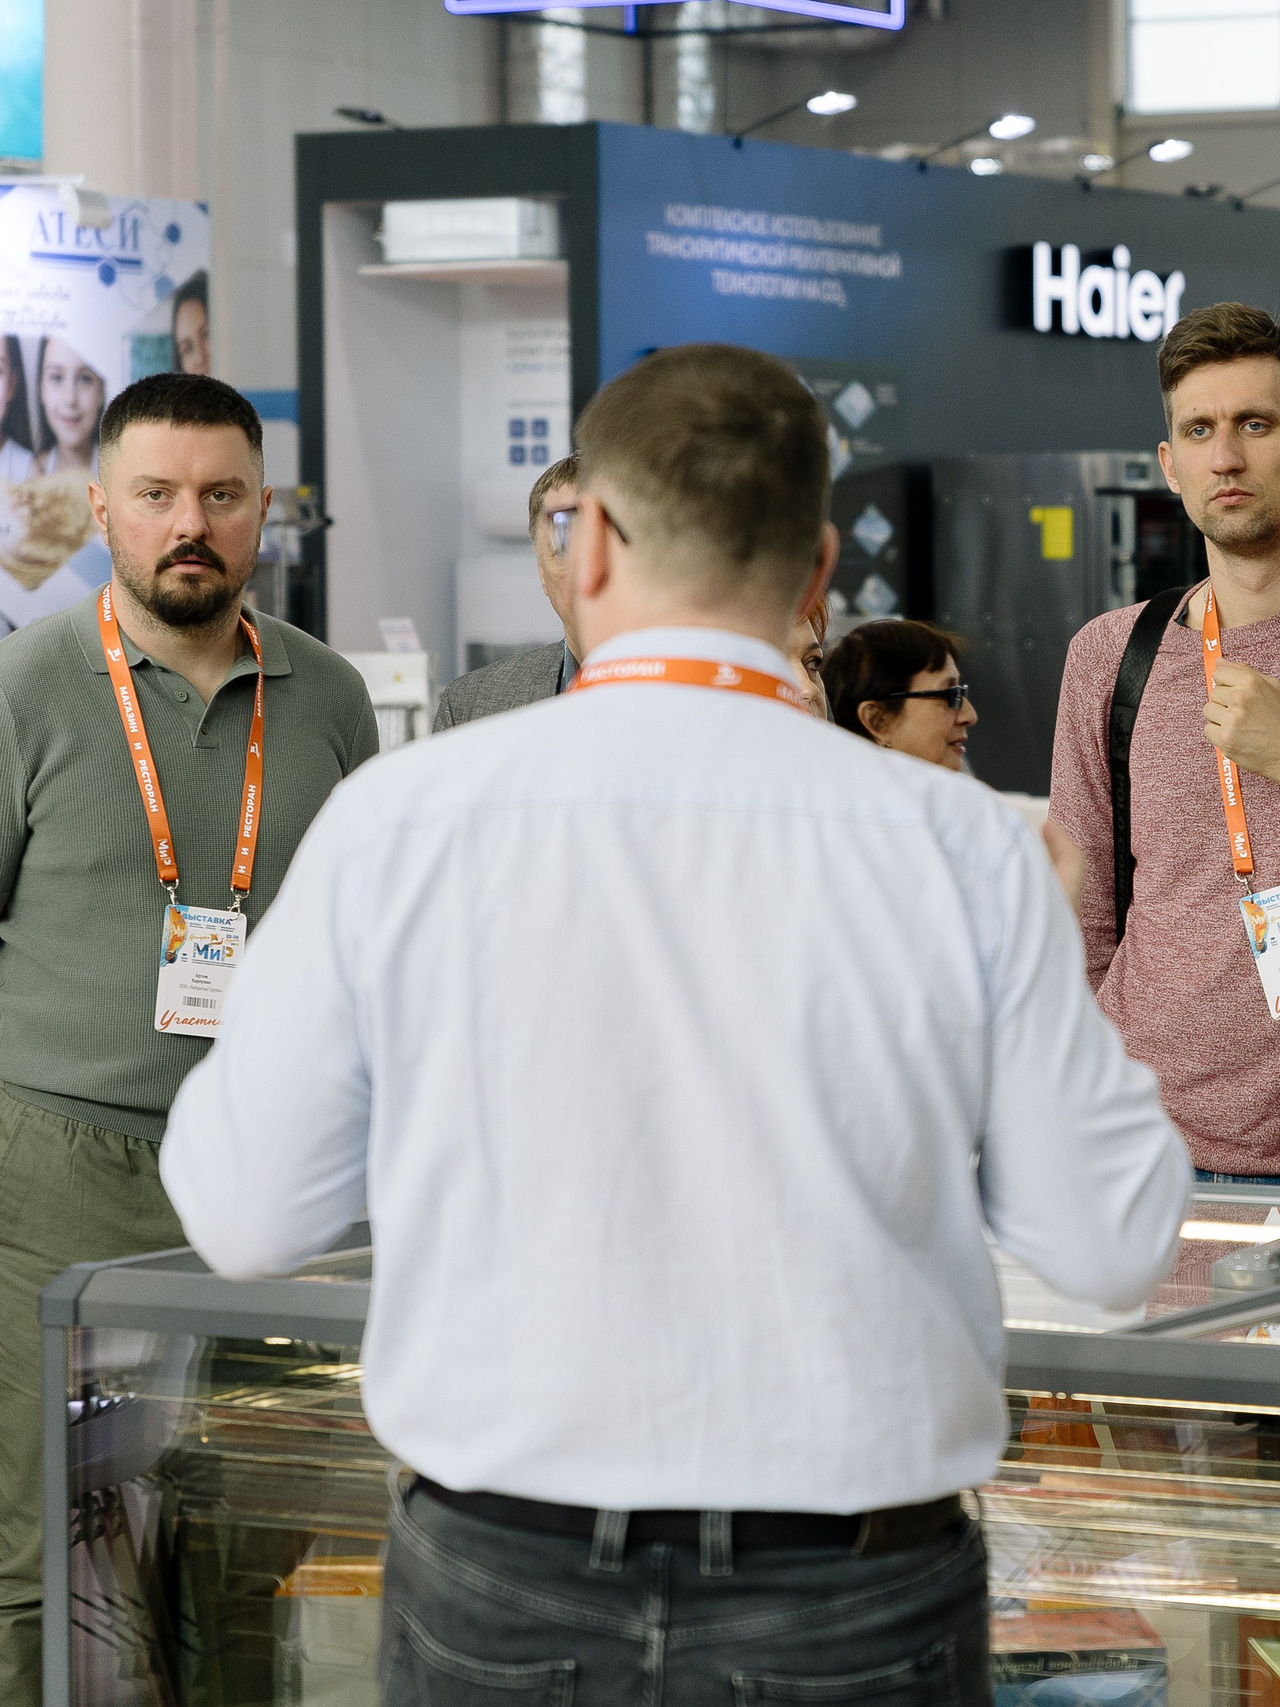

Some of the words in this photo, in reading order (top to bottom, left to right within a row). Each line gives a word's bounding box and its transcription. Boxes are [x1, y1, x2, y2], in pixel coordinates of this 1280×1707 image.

[1033, 240, 1185, 342] Haier
[102, 583, 112, 622] СТОРАН
[119, 685, 138, 733] МАГАЗИН
[133, 742, 142, 750] И
[137, 759, 158, 813] РЕСТОРАН
[243, 784, 256, 838] РЕСТОРАН
[182, 912, 231, 926] ВЫСТАВКА
[157, 1009, 223, 1031] Участн
